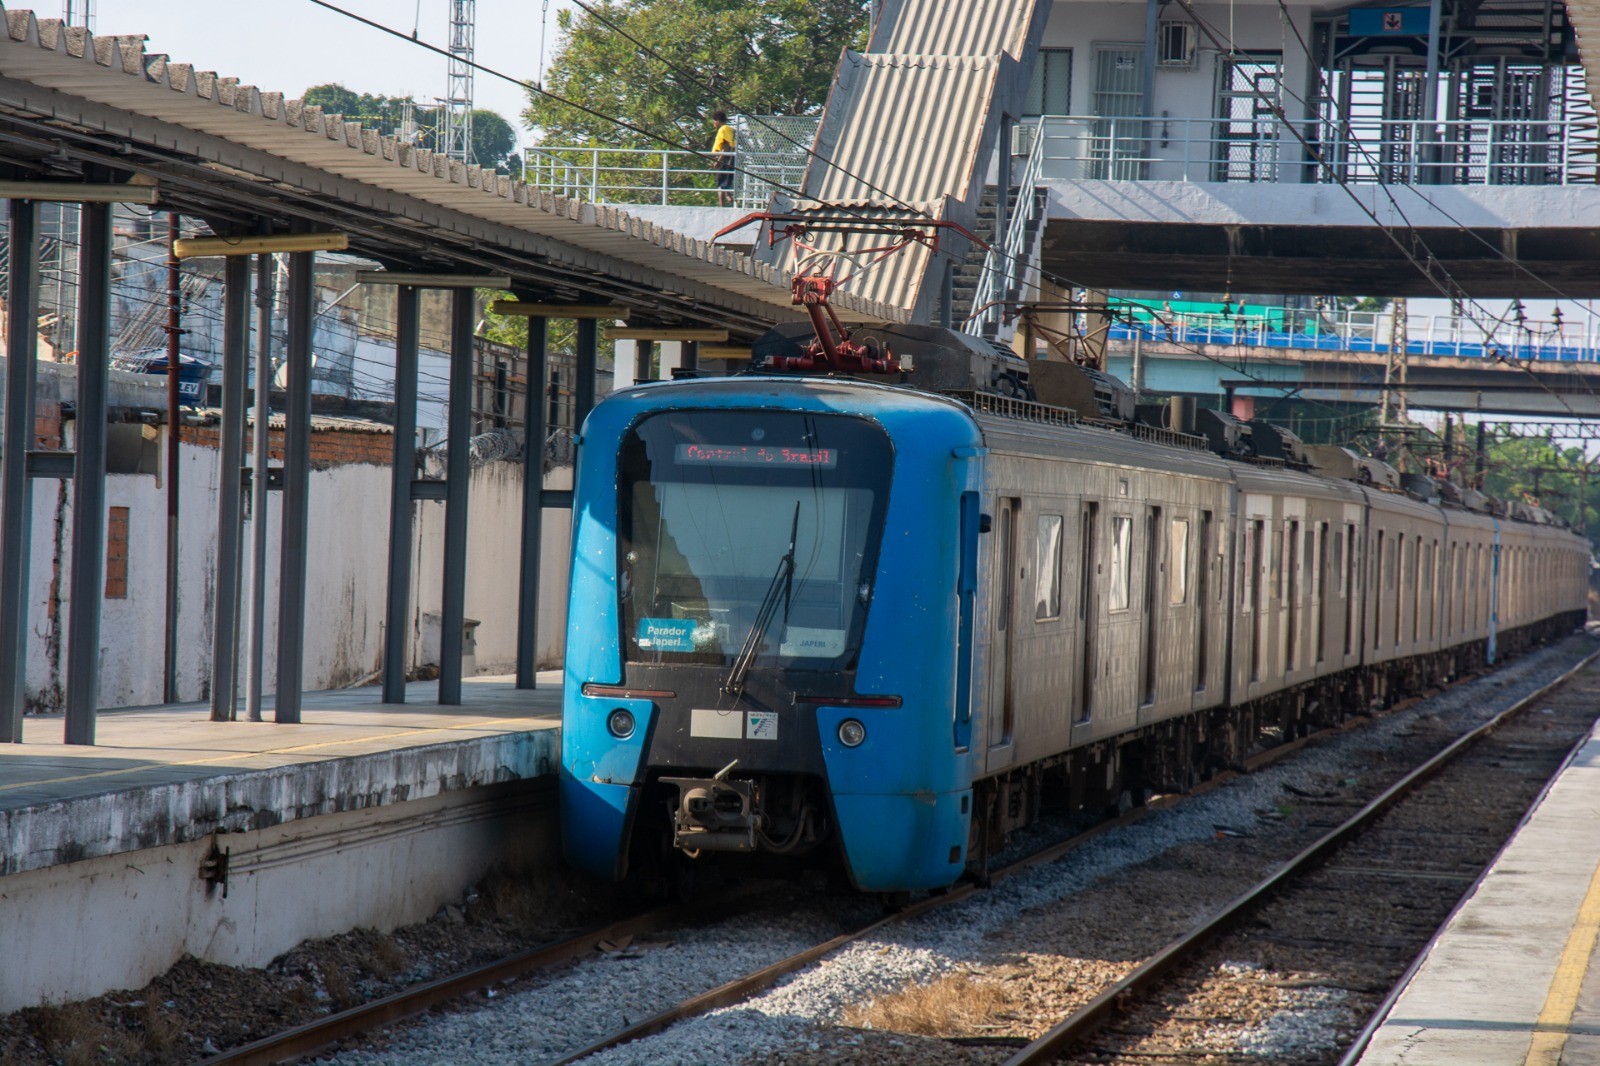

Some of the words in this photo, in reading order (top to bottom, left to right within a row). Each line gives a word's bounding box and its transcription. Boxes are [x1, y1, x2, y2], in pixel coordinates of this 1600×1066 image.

[781, 448, 830, 463] Brasil
[647, 626, 686, 635] Parador
[800, 640, 825, 648] JAPERI
